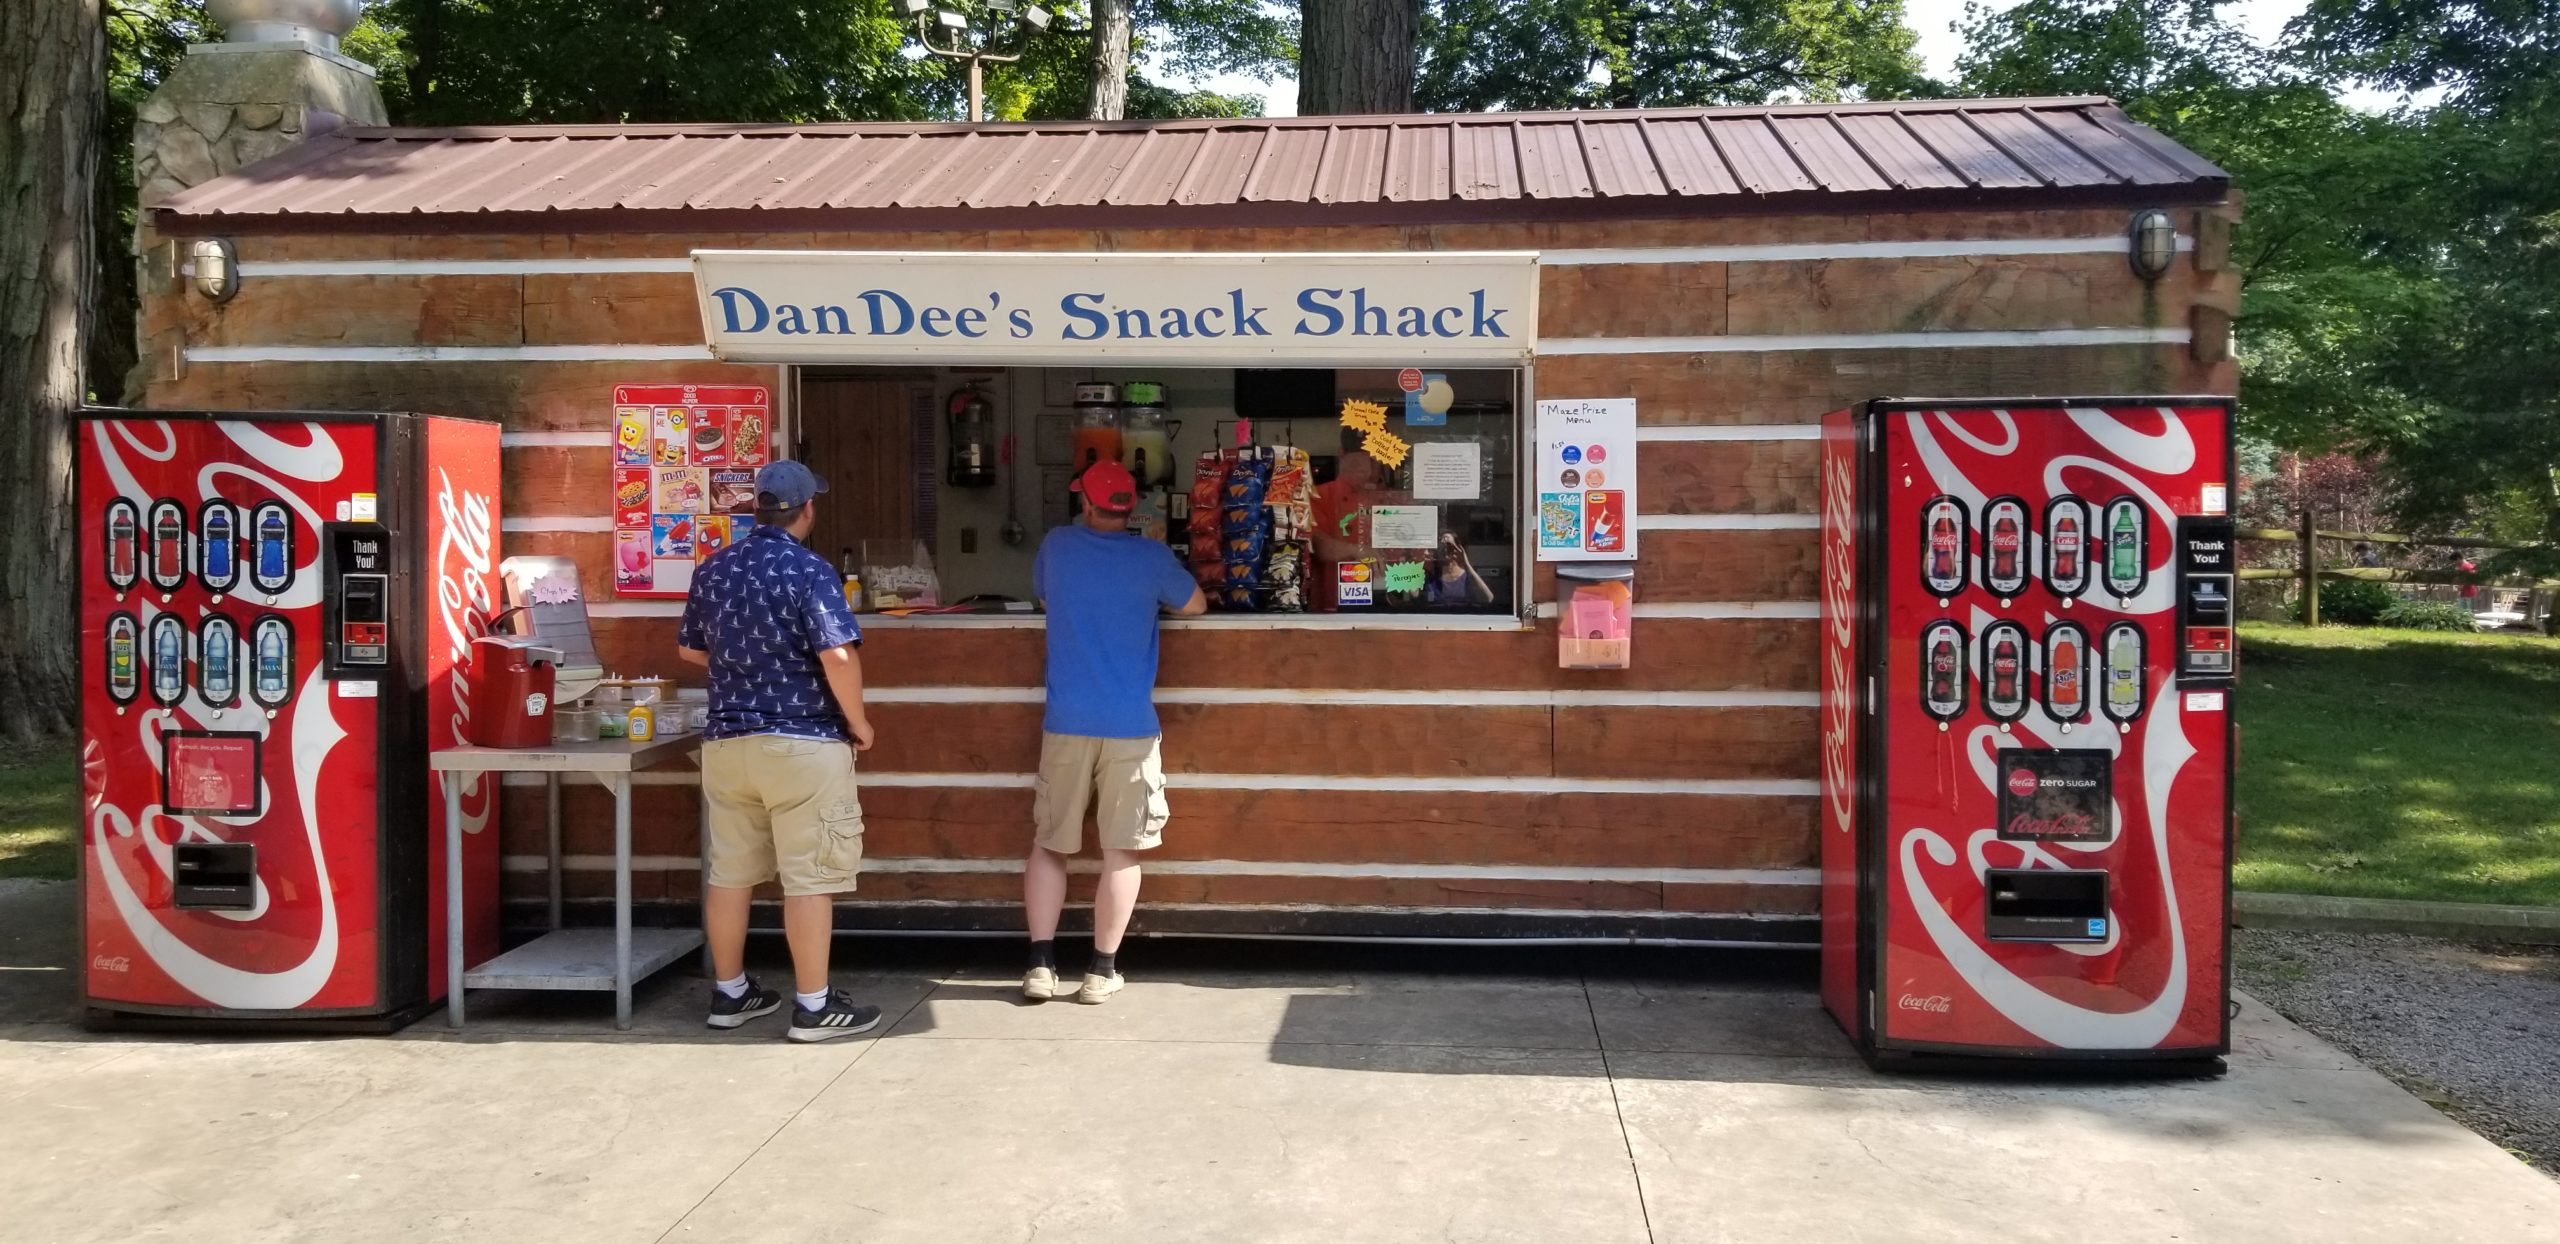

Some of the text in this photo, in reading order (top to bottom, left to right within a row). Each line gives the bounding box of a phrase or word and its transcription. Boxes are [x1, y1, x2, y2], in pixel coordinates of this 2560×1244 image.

[1061, 288, 1272, 340] Snack
[1294, 287, 1510, 338] Shack
[1547, 403, 1607, 415] Maze Prize
[714, 473, 750, 482] SNICKERS
[1932, 534, 1957, 546] Coca-Cola
[1992, 534, 2018, 546] Coca-Cola
[2056, 537, 2076, 545] Coke
[2189, 541, 2225, 550] Thank
[353, 540, 378, 553] Thank
[355, 555, 375, 568] You!
[2194, 554, 2220, 564] You!
[1344, 586, 1369, 597] VISA
[1825, 438, 1851, 833] Coca-Cola
[1994, 658, 2017, 667] Coca-Cola
[2055, 672, 2077, 685] Fanta
[2008, 778, 2037, 787] Coca-Cola
[2040, 779, 2065, 787] zero
[94, 955, 130, 972] Coca-Cola
[1898, 993, 1952, 1013] Coca-Cola
